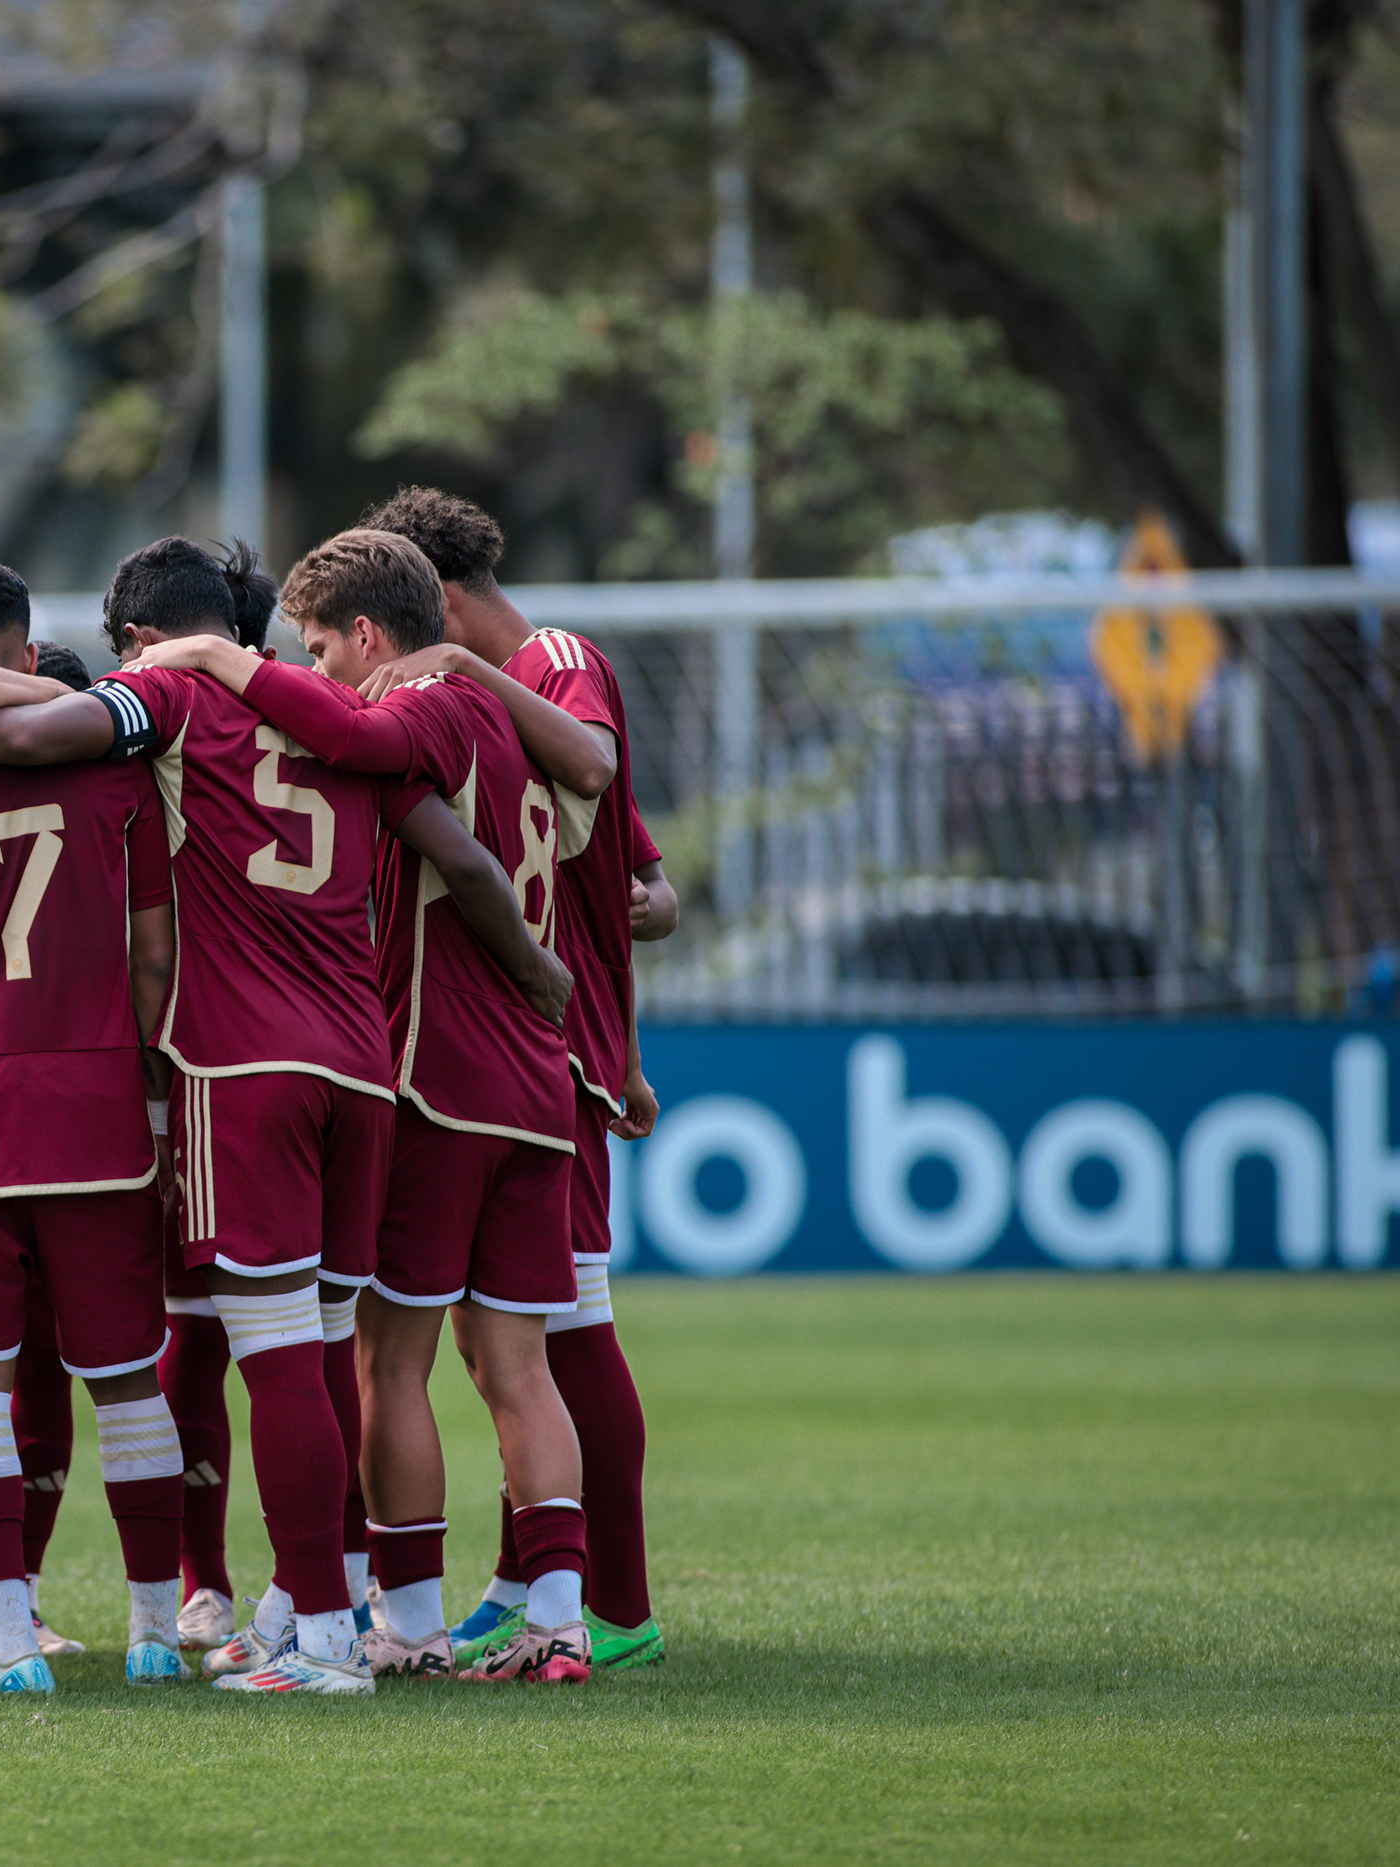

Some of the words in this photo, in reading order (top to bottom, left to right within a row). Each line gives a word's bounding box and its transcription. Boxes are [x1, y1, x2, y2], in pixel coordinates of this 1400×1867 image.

[247, 725, 336, 895] 5
[513, 778, 557, 946] 8
[281, 1663, 325, 1680] F50
